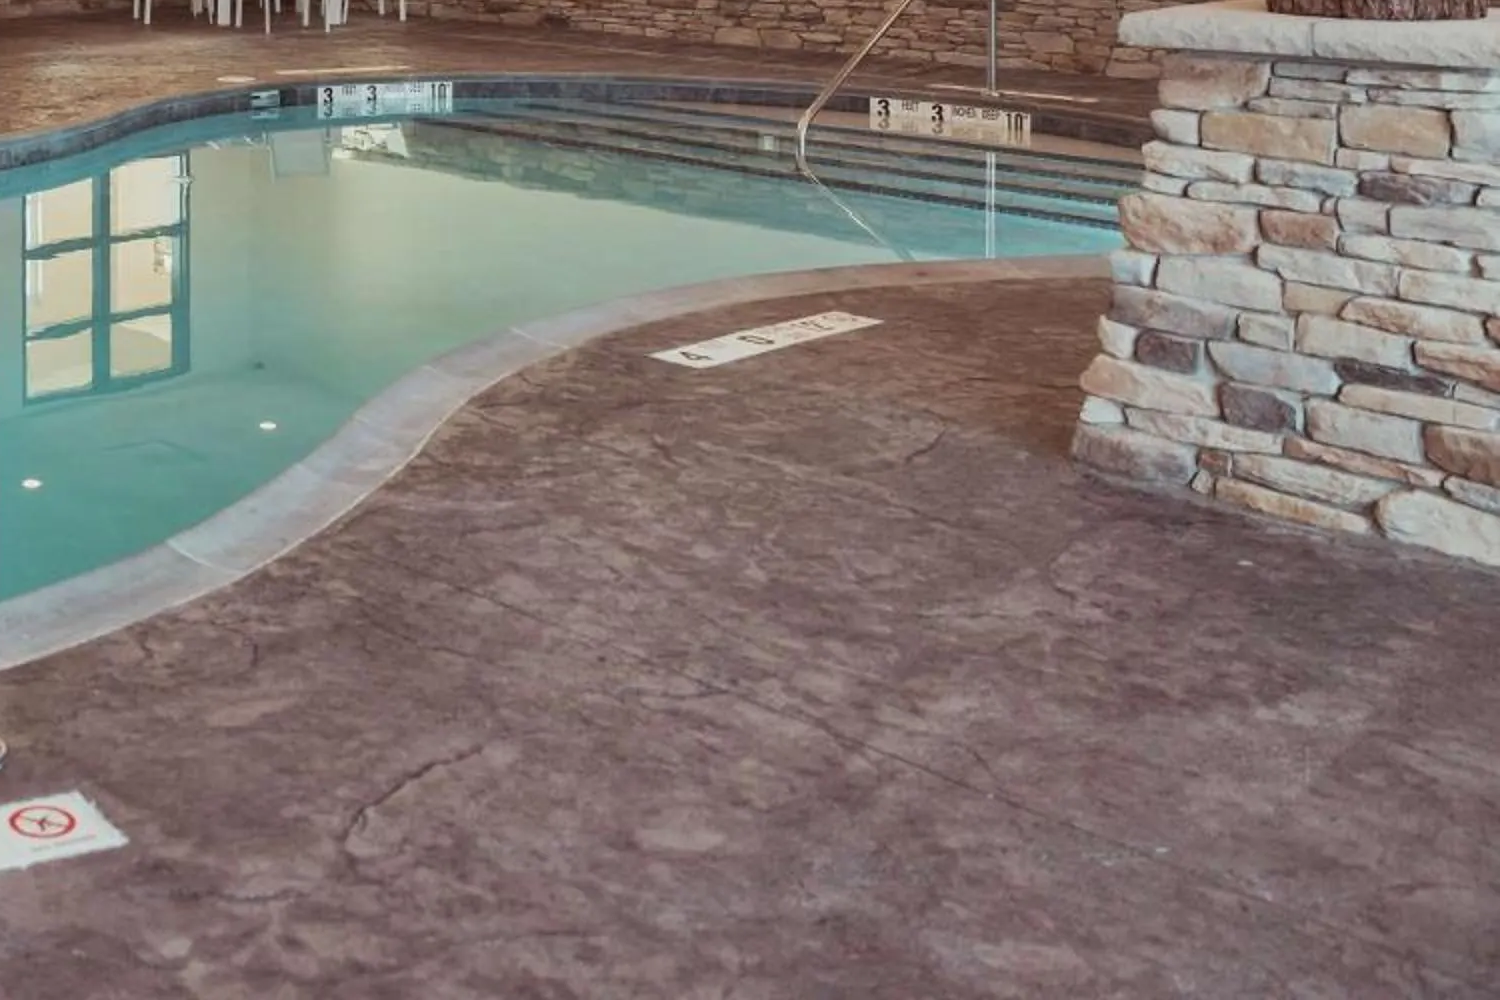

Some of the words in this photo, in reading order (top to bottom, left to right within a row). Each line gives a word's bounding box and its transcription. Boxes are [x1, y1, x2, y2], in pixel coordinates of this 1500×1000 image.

[323, 87, 333, 104] 3
[878, 99, 890, 118] 3
[931, 104, 944, 122] 3
